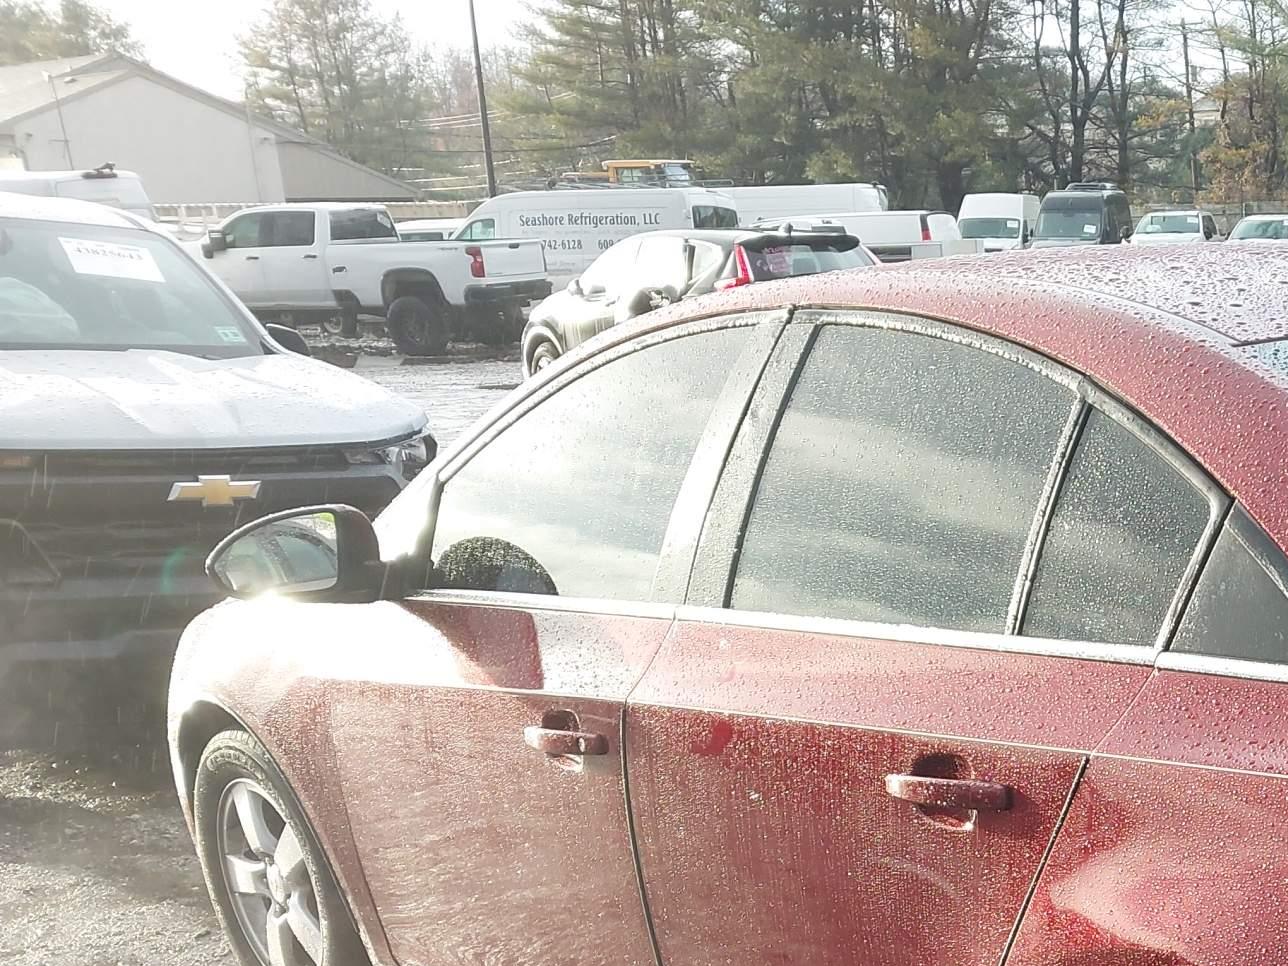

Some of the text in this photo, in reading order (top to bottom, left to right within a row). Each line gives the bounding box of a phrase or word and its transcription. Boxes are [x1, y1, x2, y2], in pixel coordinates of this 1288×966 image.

[519, 212, 661, 228] Seashore Refrigeration, LLC
